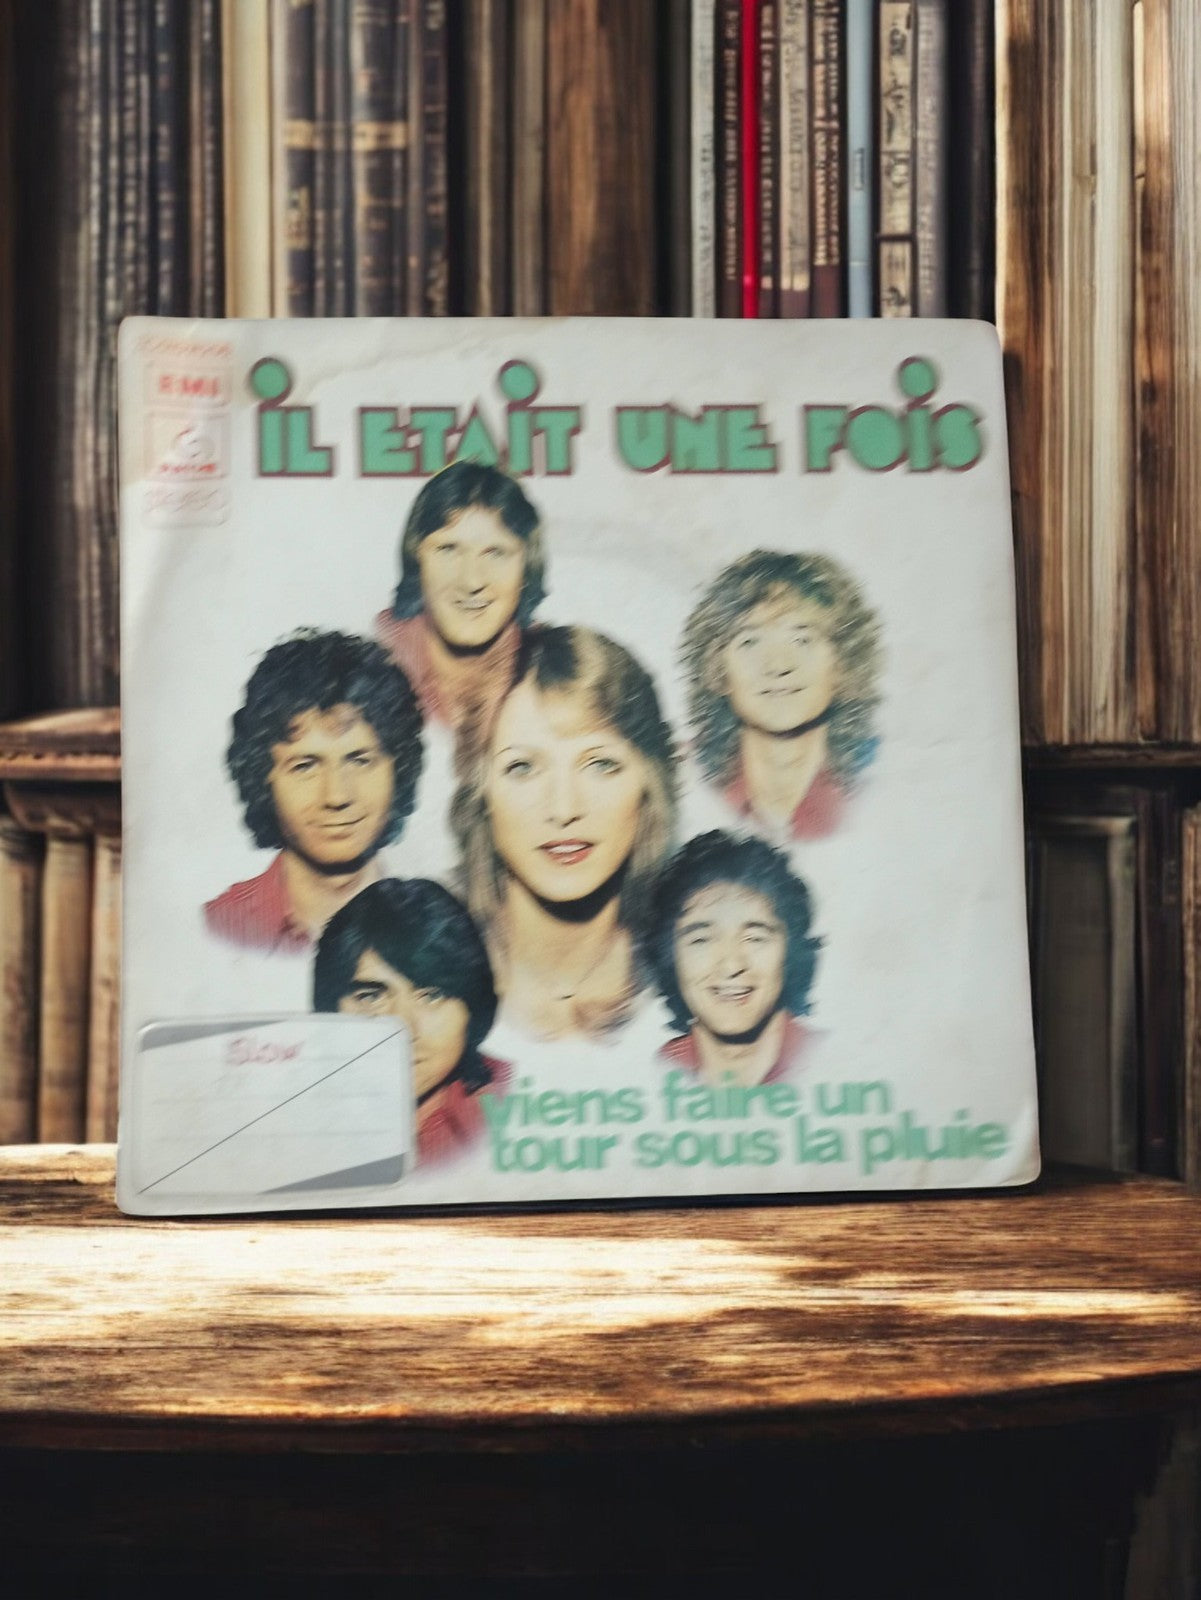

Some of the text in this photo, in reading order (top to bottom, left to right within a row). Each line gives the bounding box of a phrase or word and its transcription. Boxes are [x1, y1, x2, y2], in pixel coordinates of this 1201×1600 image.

[614, 401, 779, 474] UNE
[480, 1069, 893, 1126] viens faire un
[491, 1108, 1009, 1176] tour sous la pluie
